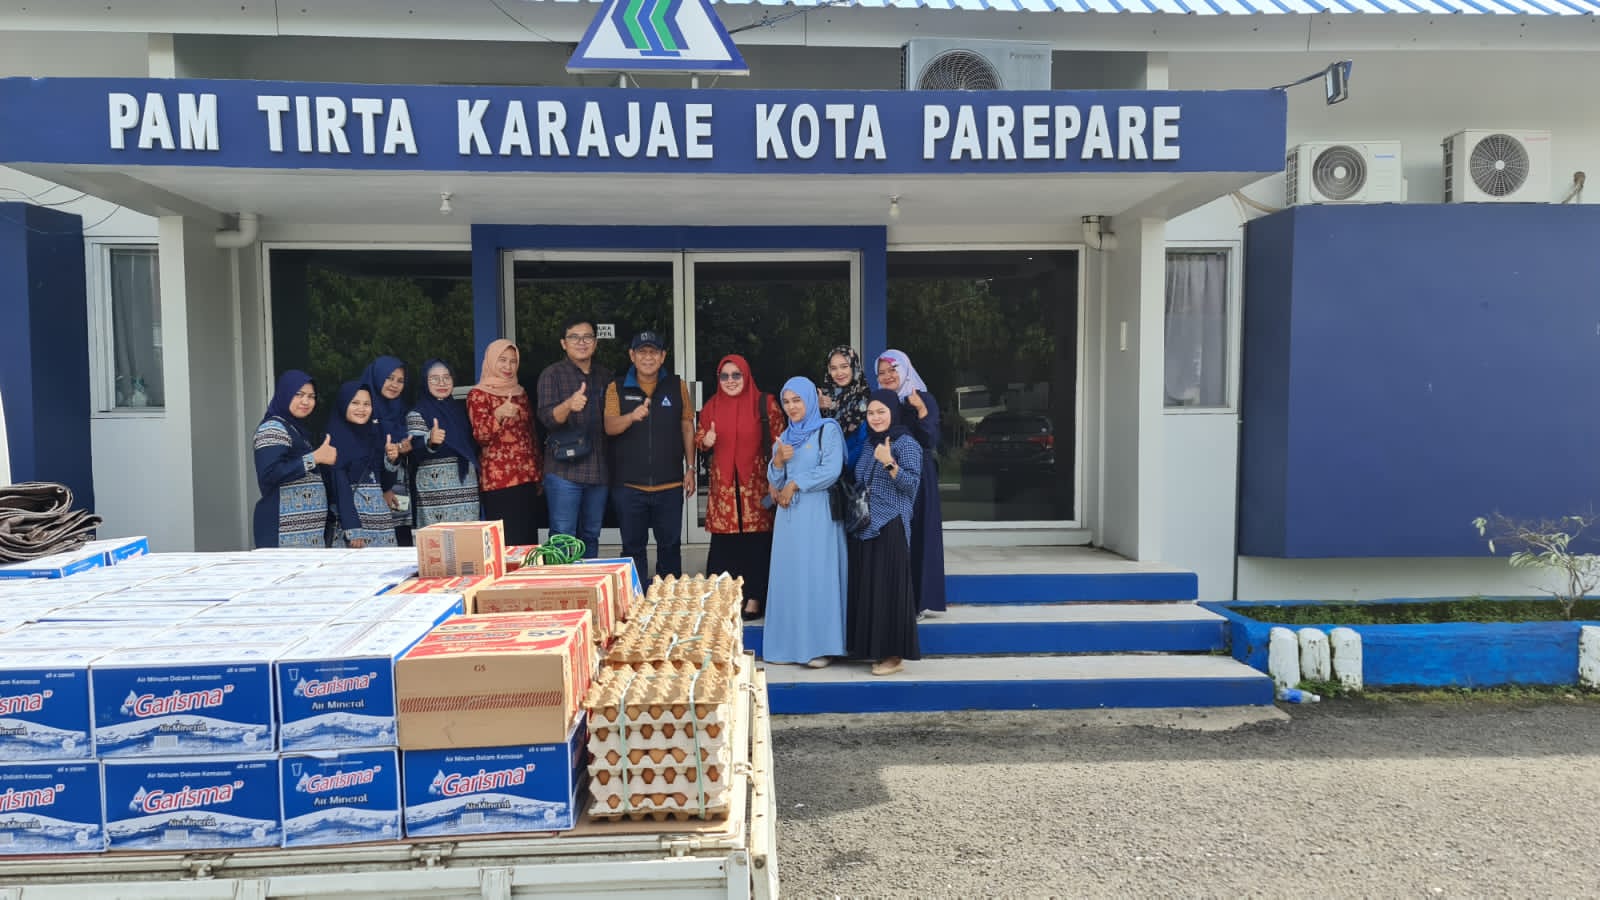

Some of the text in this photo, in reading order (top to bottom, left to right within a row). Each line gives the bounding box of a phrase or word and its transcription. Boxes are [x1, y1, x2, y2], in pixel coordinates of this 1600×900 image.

[109, 93, 1181, 160] PAM TIRTA KARAJAE KOTA PAREPARE
[327, 699, 365, 709] Mineral
[329, 793, 368, 804] Mineral
